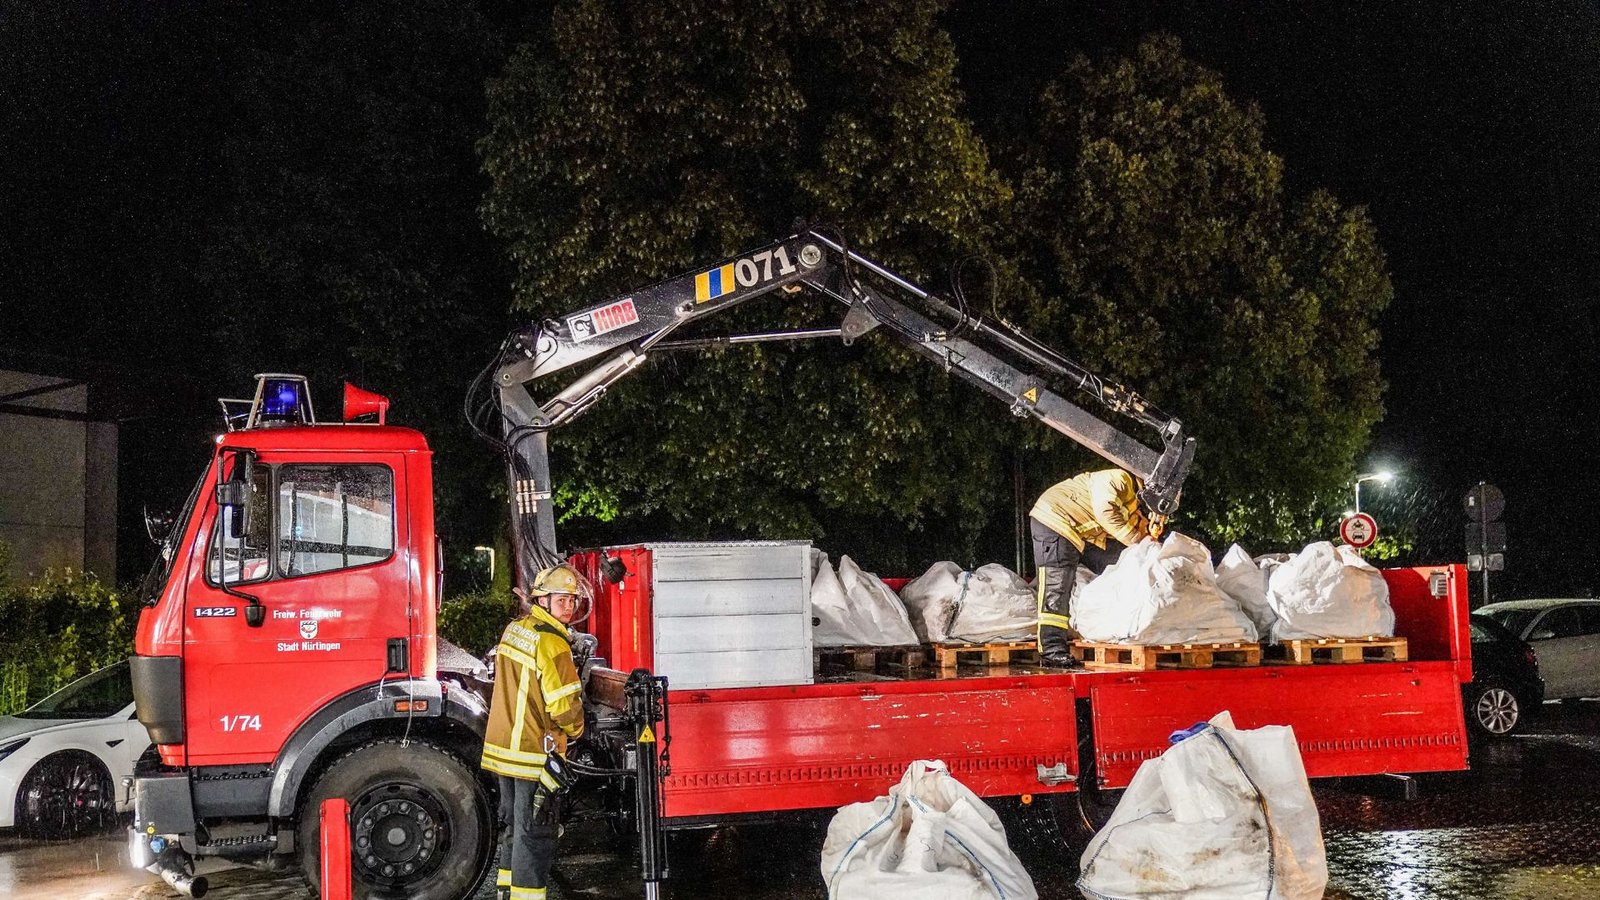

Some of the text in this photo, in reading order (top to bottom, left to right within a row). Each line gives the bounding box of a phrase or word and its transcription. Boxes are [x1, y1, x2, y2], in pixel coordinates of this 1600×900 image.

[735, 246, 796, 287] 071
[594, 302, 636, 331] HIAB
[195, 607, 236, 617] 1422
[273, 610, 298, 619] Freiw.
[277, 641, 341, 652] Stadt Nürtingen
[220, 715, 262, 731] 1/74
